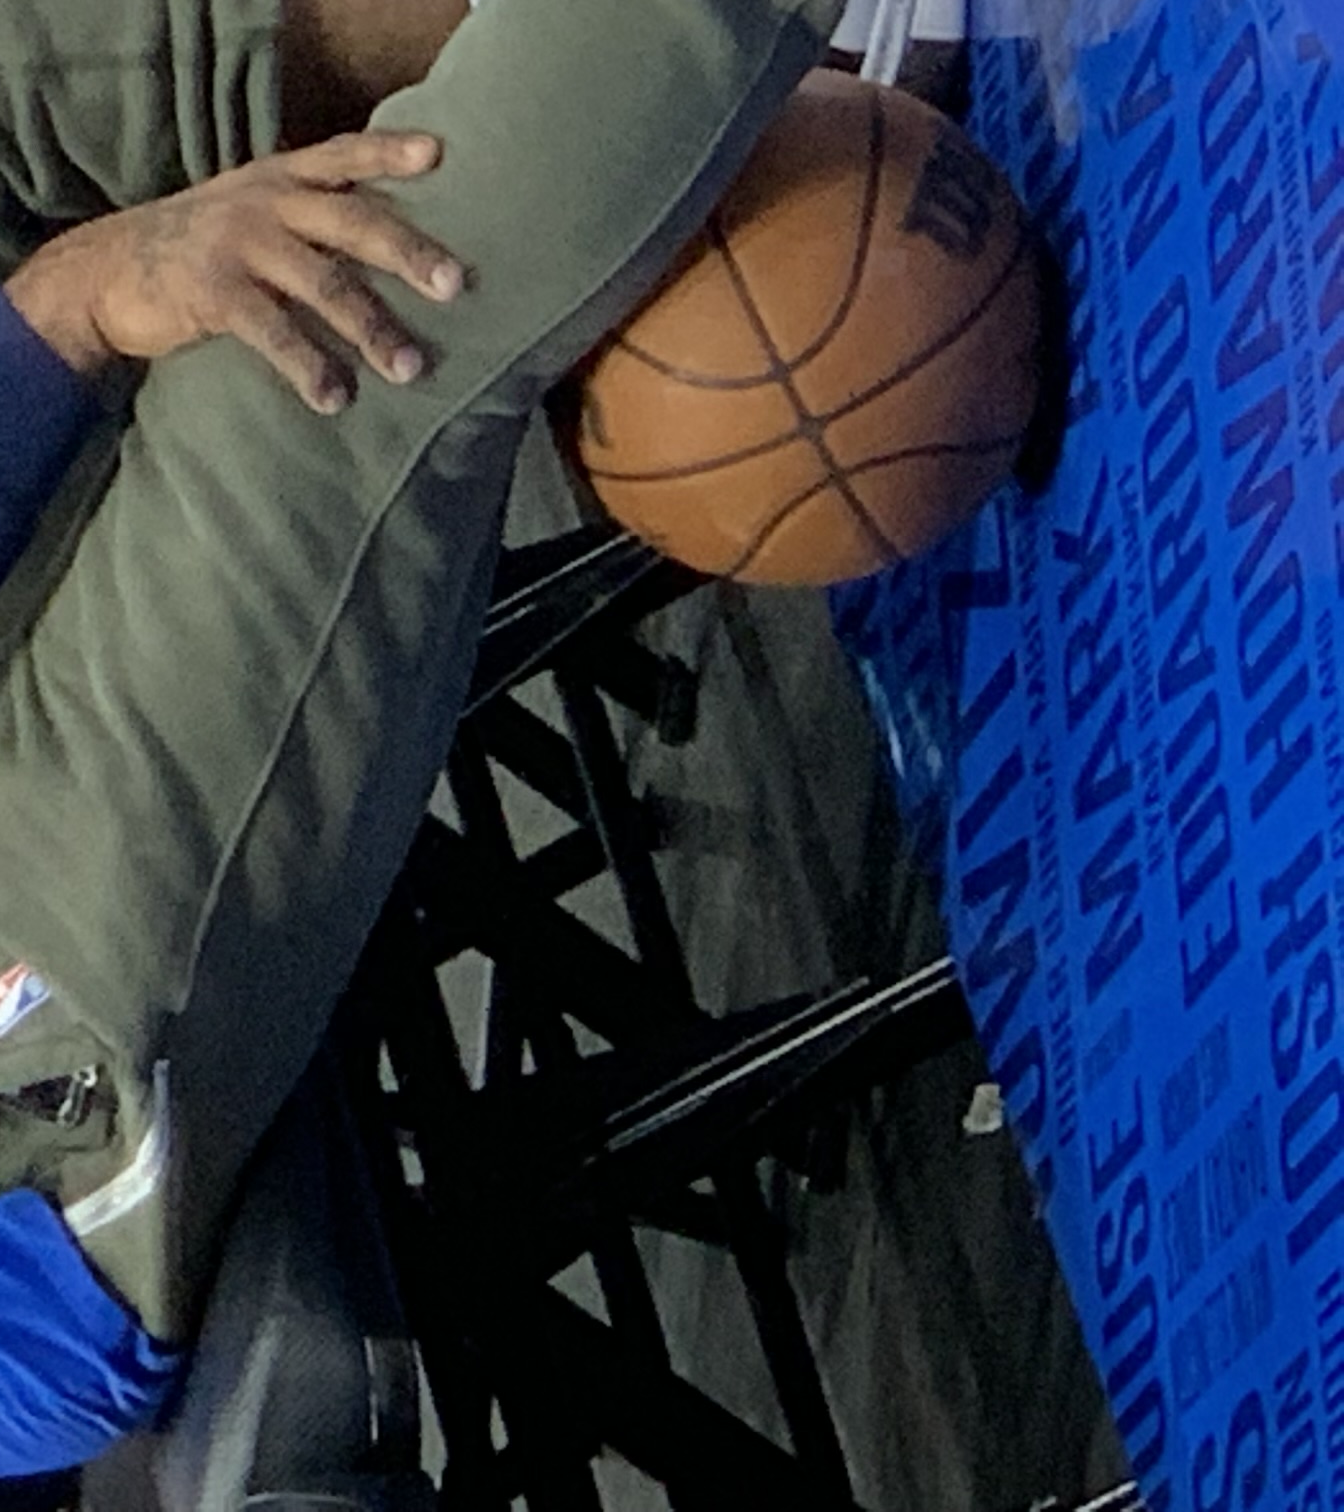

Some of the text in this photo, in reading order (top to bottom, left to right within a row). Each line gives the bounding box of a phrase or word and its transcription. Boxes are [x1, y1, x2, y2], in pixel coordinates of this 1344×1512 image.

[1052, 454, 1144, 1004] MARK
[1131, 273, 1240, 1010] EDUARDO
[1197, 20, 1315, 824] HOWARD
